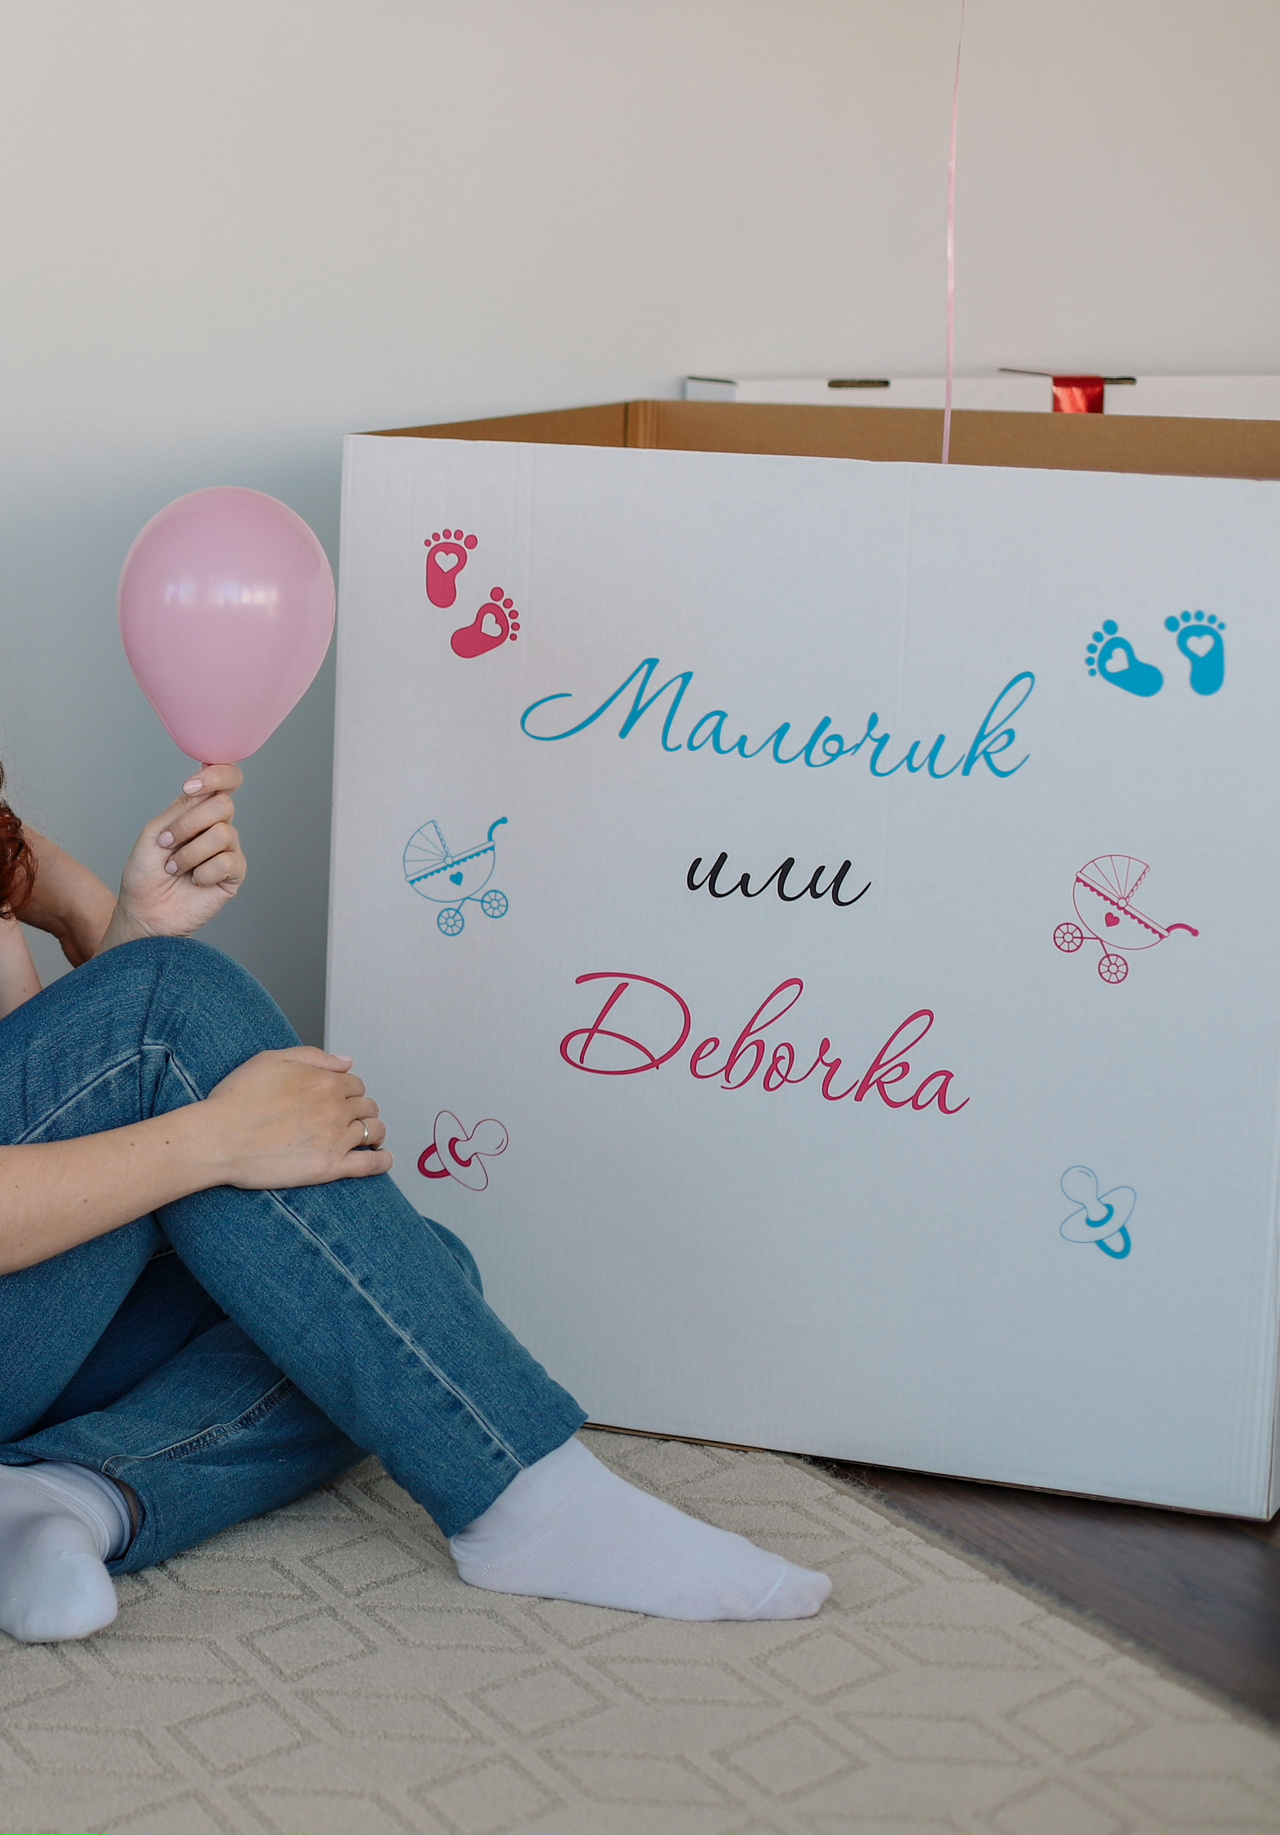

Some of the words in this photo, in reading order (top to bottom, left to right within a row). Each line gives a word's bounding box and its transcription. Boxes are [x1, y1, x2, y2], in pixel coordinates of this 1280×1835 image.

[519, 657, 1036, 779] Мальчик
[685, 852, 872, 907] или
[559, 971, 971, 1115] Девочка
